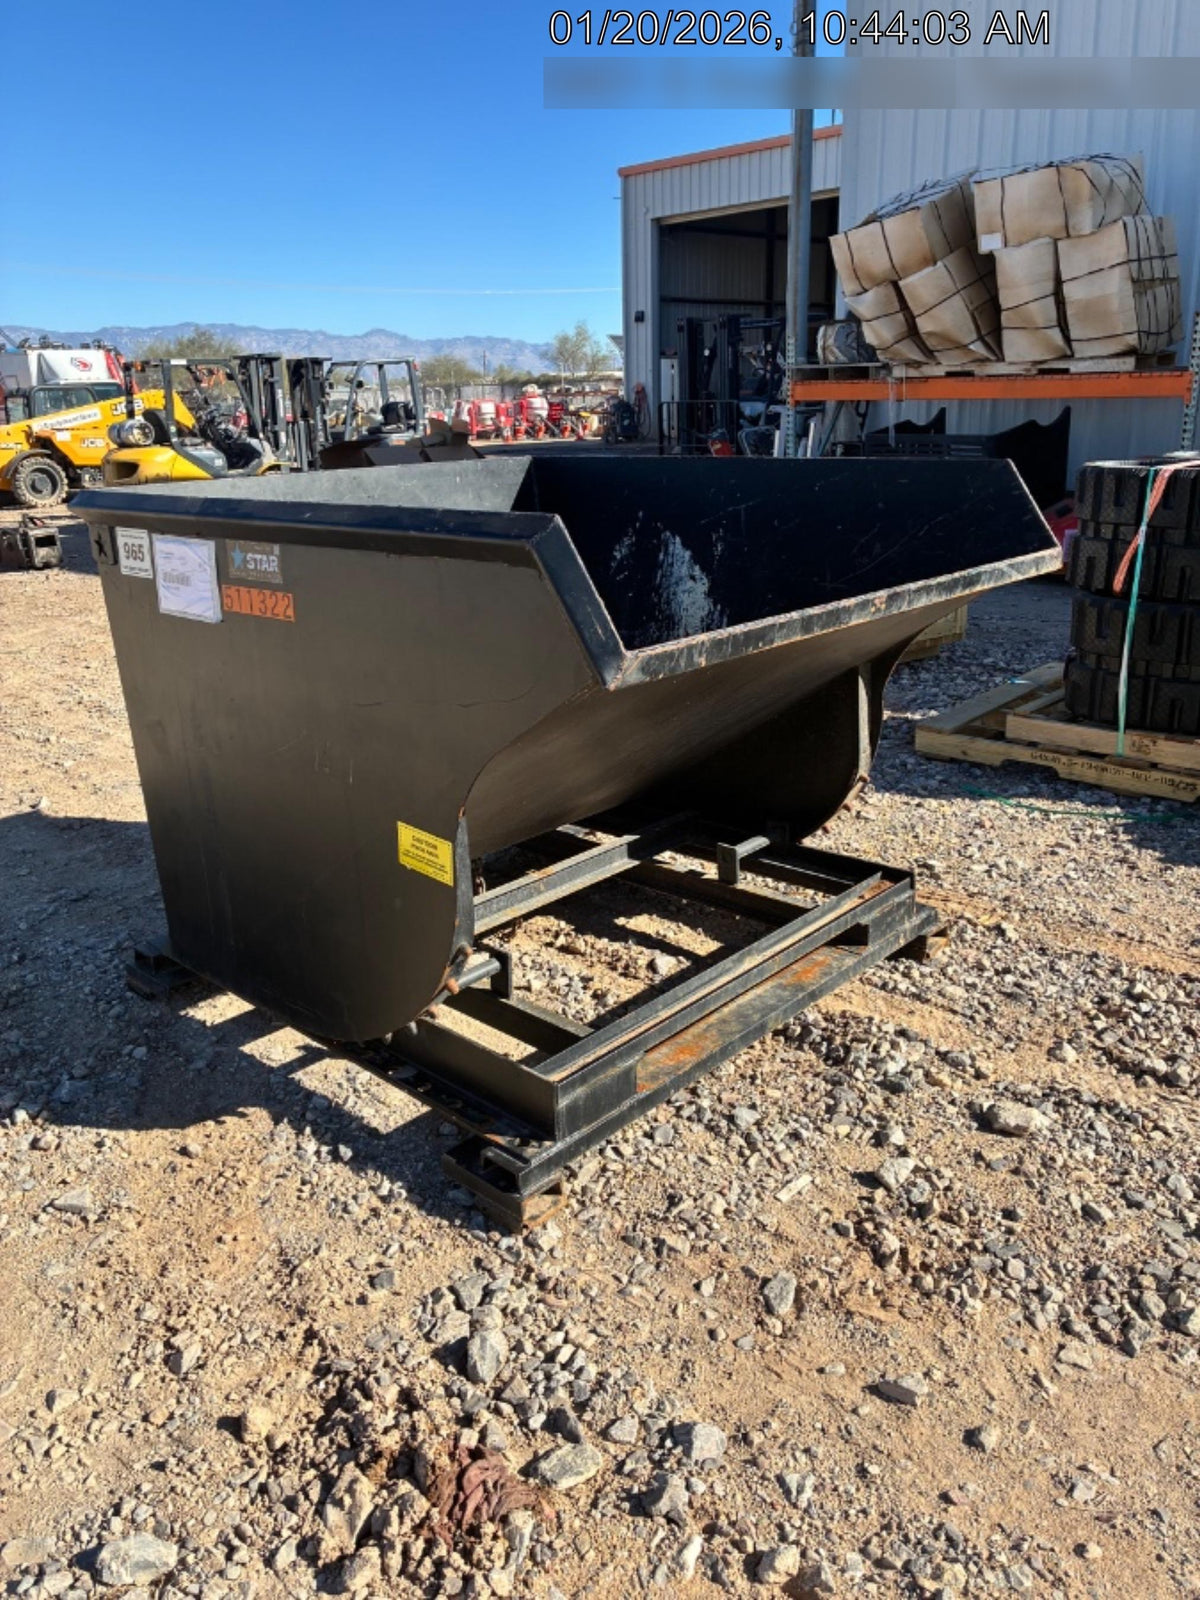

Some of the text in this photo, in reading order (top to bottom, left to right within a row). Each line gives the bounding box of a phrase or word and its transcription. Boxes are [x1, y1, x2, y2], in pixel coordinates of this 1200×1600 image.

[123, 541, 145, 563] 965
[246, 552, 279, 573] STAR
[224, 588, 292, 619] 511322
